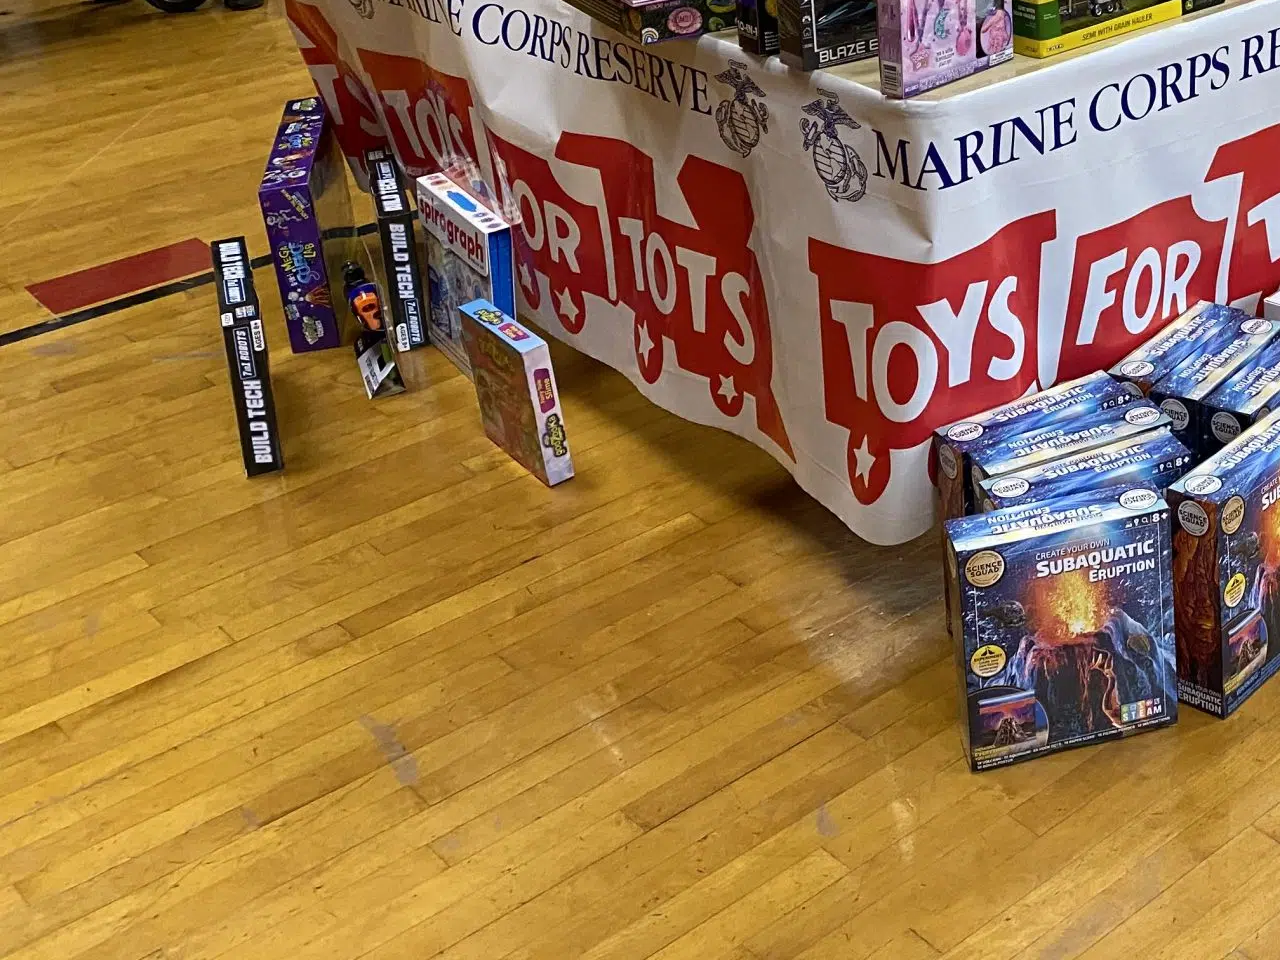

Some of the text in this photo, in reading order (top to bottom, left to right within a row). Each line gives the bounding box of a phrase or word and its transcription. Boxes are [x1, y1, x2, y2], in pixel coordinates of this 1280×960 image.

[1082, 14, 1153, 40] SEMI WITH GRAIN HAULER
[472, 2, 570, 68] CORPS
[577, 32, 712, 118] RESERVE
[819, 42, 868, 63] BLAZE
[873, 99, 1078, 192] MARINE
[1089, 52, 1229, 132] CORPS
[389, 222, 408, 261] BUILD
[419, 198, 485, 265] spirograph
[394, 262, 414, 298] TECH
[512, 178, 580, 273] OR
[619, 216, 754, 366] TOTS
[829, 275, 1026, 424] TOYS
[1075, 239, 1200, 346] FOR
[994, 385, 1088, 422] SUBAQUATIC
[242, 380, 273, 463] BUILD TECH
[1176, 456, 1190, 467] 8+
[1152, 512, 1168, 523] 8+
[1178, 509, 1208, 523] SCIENCE
[1035, 538, 1110, 561] CREATE YOUR OWN
[1036, 540, 1155, 578] SUBAQUATIC
[966, 560, 1003, 574] SCIENCE
[970, 568, 1000, 578] SQUAD
[1088, 559, 1156, 583] ERUPTION
[1122, 705, 1162, 722] STEAM
[1178, 691, 1222, 714] ERUPTION
